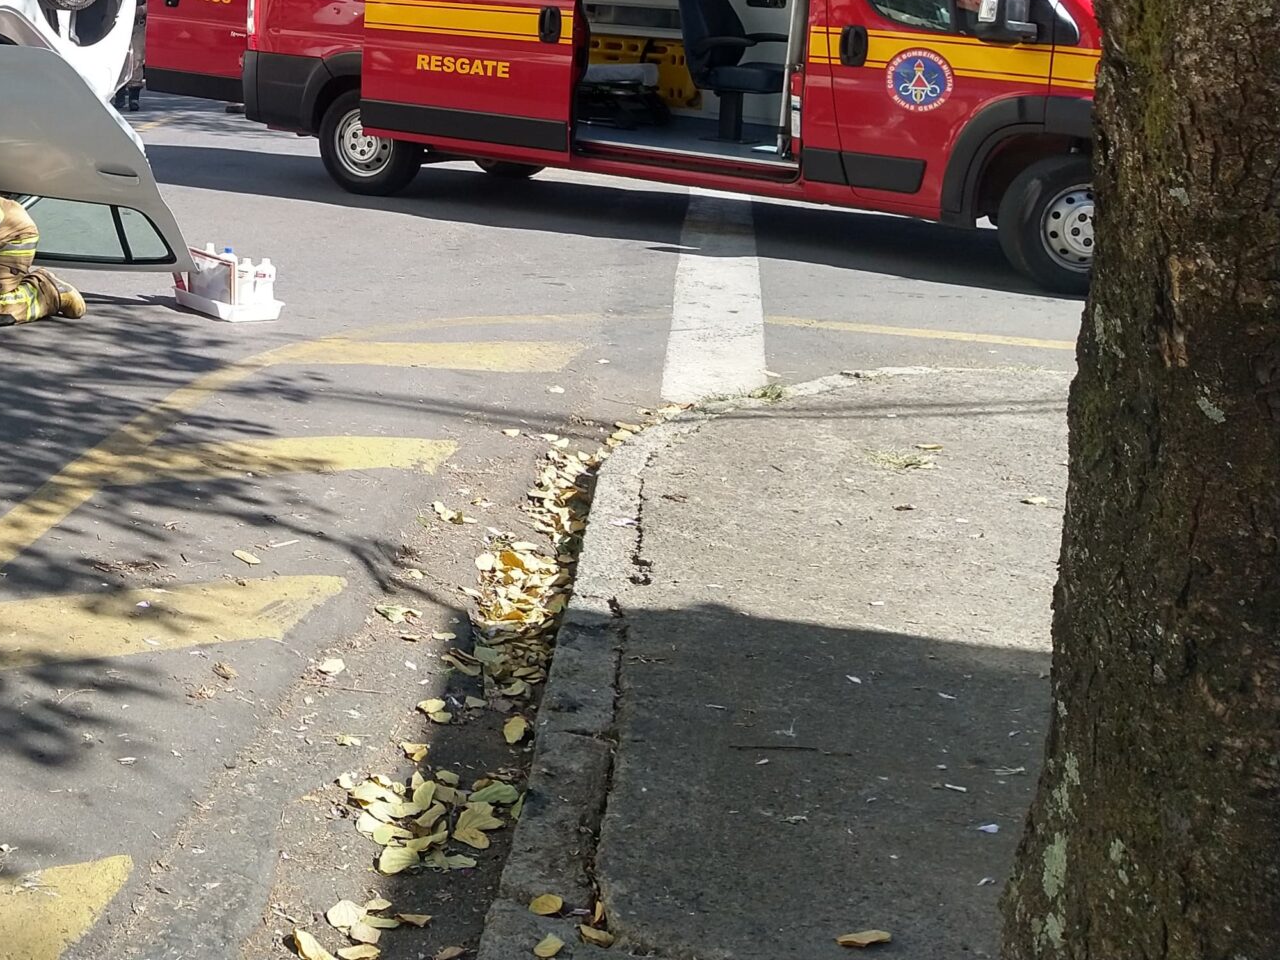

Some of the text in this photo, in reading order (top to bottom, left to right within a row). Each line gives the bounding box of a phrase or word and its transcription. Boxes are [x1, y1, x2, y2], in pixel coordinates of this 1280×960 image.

[416, 54, 510, 78] RESGATE
[892, 94, 946, 112] MINAS GERAIS
